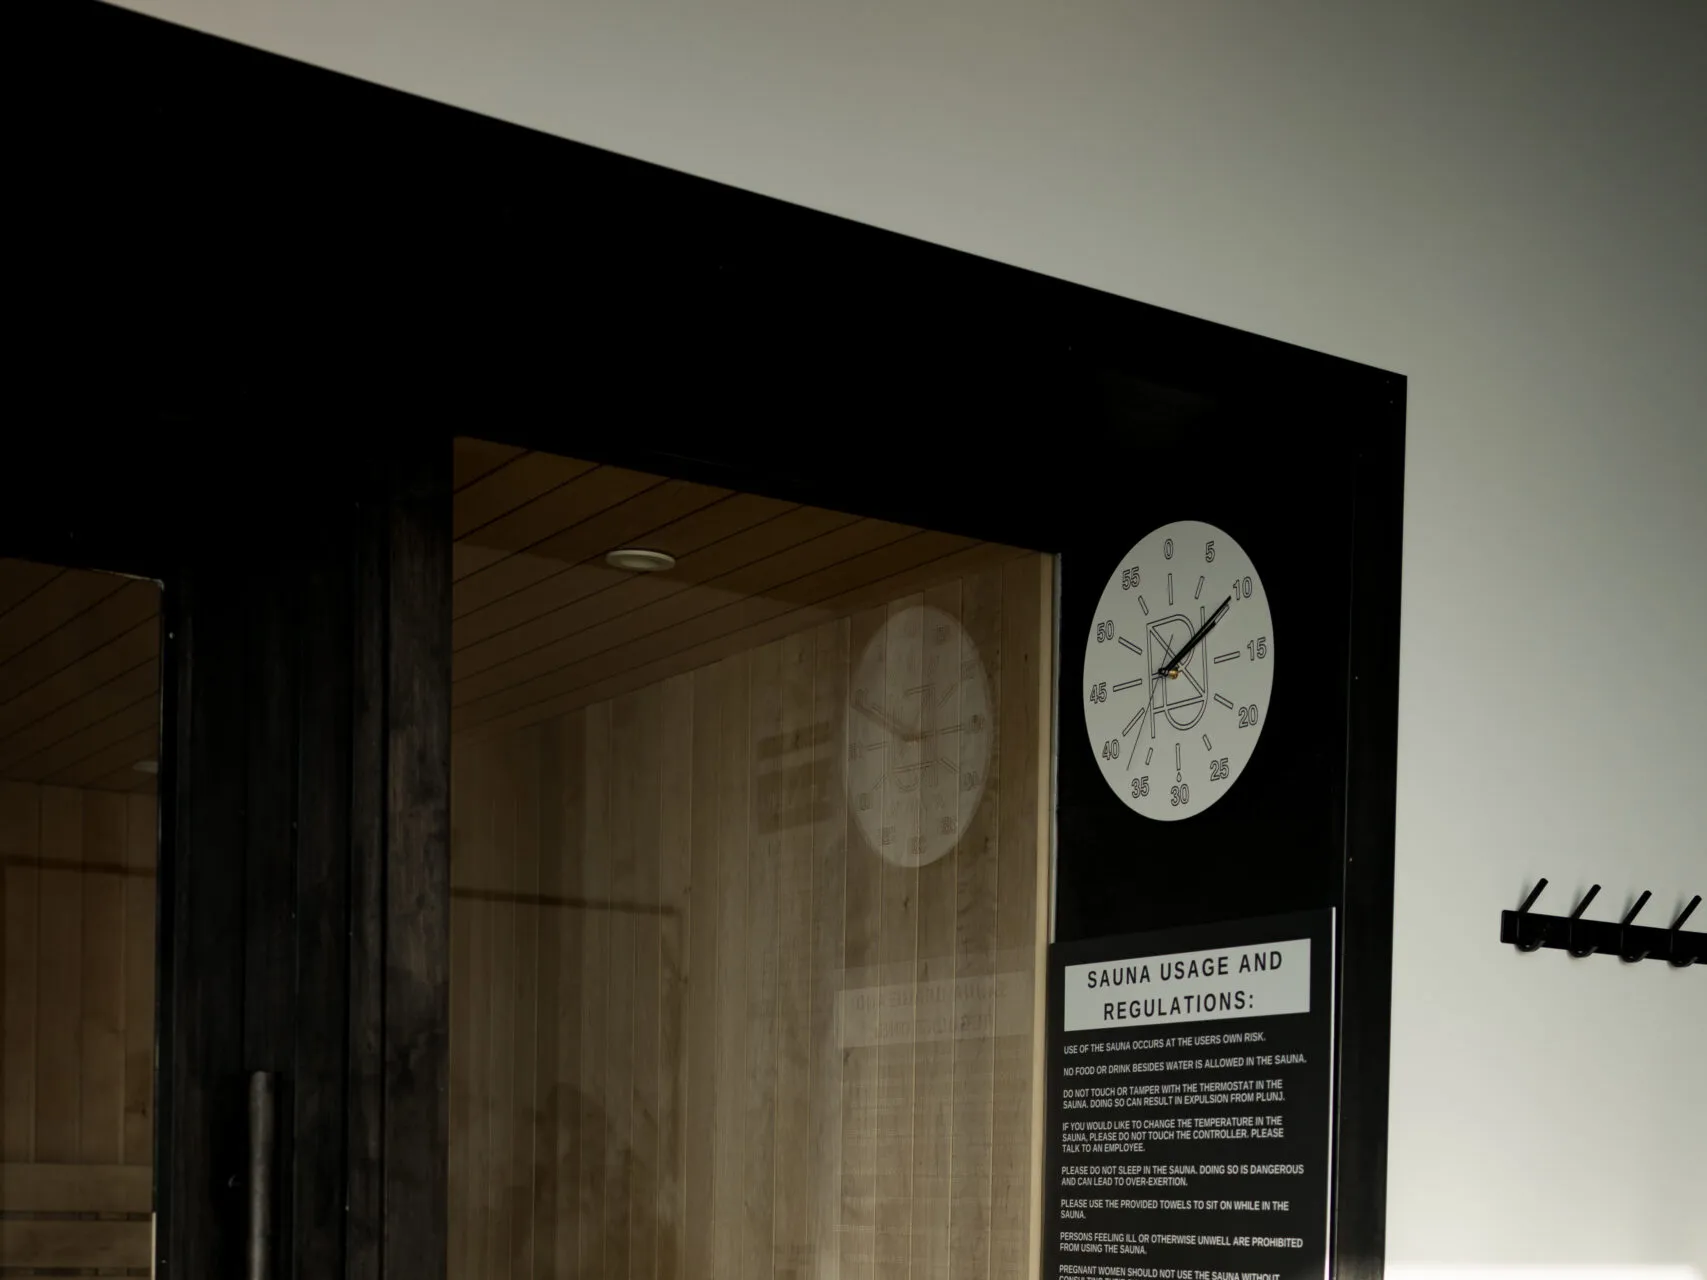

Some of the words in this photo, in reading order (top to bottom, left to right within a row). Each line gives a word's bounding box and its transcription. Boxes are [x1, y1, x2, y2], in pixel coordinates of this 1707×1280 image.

[1164, 539, 1174, 559] 0
[1205, 541, 1215, 562] 5
[1122, 567, 1140, 590] 55
[1233, 577, 1252, 600] 10
[1097, 620, 1114, 642] 50
[1247, 637, 1267, 661] 15
[1090, 682, 1107, 703] 45
[1238, 704, 1258, 728] 20
[1102, 739, 1120, 760] 40
[1210, 758, 1229, 781] 25
[1132, 776, 1149, 798] 35
[1171, 784, 1189, 806] 30
[1087, 965, 1150, 988] SAUNA
[1160, 956, 1228, 980] USAGE
[1239, 950, 1282, 973] AND
[1104, 990, 1254, 1020] REGULATIONS:
[1064, 1045, 1078, 1054] USE
[1079, 1044, 1089, 1053] OF
[1091, 1043, 1104, 1052] THE
[1106, 1042, 1131, 1051] SAUNA
[1132, 1039, 1164, 1050] OCCURS
[1166, 1038, 1176, 1047] AT
[1178, 1037, 1193, 1047] THE
[1194, 1036, 1221, 1046] USERS
[1223, 1034, 1242, 1044] OWN
[1244, 1032, 1266, 1042] RISK.
[1063, 1068, 1074, 1076] NO
[1075, 1066, 1095, 1075] FOOD
[1097, 1066, 1107, 1074] OR
[1109, 1064, 1131, 1074] DRINK
[1132, 1062, 1164, 1072] BESIDES
[1166, 1060, 1194, 1071] WATER
[1195, 1060, 1203, 1069] IS
[1205, 1058, 1244, 1069] ALLOWED
[1246, 1057, 1254, 1067] IN
[1256, 1056, 1273, 1066] THE
[1274, 1054, 1306, 1065] SAUNA.
[1063, 1089, 1073, 1098] DO
[1075, 1088, 1089, 1098] NOT
[1091, 1087, 1115, 1097] TOUCH
[1117, 1087, 1128, 1096] OR
[1130, 1085, 1160, 1095] TAMPER
[1162, 1084, 1181, 1094] WITH
[1182, 1083, 1198, 1093] THE
[1200, 1081, 1254, 1092] THERMOSTAT
[1255, 1080, 1264, 1090] IN
[1266, 1080, 1283, 1090] THE
[1063, 1099, 1088, 1109] SAUNA.
[1090, 1098, 1113, 1108] DOING
[1114, 1098, 1125, 1107] SO
[1126, 1097, 1142, 1107] CAN
[1144, 1096, 1173, 1106] RESULT
[1175, 1096, 1182, 1105] IN
[1184, 1094, 1228, 1105] EXPULSION
[1230, 1093, 1254, 1103] FROM
[1256, 1092, 1285, 1102] PLUNJ.
[1062, 1122, 1069, 1131] IF
[1070, 1122, 1085, 1130] YOU
[1087, 1121, 1112, 1130] WOULD
[1114, 1120, 1130, 1129] LIKE
[1132, 1120, 1142, 1129] TO
[1144, 1119, 1176, 1129] CHANGE
[1177, 1119, 1193, 1128] THE
[1194, 1117, 1253, 1127] TEMPERATURE
[1255, 1117, 1264, 1126] IN
[1266, 1116, 1283, 1126] THE
[1089, 1132, 1117, 1141] PLEASE
[1119, 1132, 1129, 1141] DO
[1131, 1131, 1147, 1140] NOT
[1148, 1131, 1174, 1140] TOUCH
[1176, 1130, 1191, 1140] THE
[1193, 1129, 1248, 1139] CONTROLLER.
[1250, 1128, 1284, 1138] PLEASE
[1062, 1144, 1080, 1152] TALK
[1082, 1144, 1091, 1152] TO
[1093, 1144, 1103, 1152] AN
[1104, 1143, 1145, 1152] EMPLOYEE.
[1062, 1166, 1088, 1174] PLEASE
[1090, 1166, 1100, 1174] DO
[1102, 1166, 1117, 1174] NOT
[1118, 1165, 1142, 1174] SLEEP
[1144, 1165, 1151, 1174] IN
[1153, 1165, 1167, 1174] THE
[1169, 1165, 1198, 1174] SAUNA.
[1199, 1165, 1225, 1174] DOING
[1227, 1165, 1239, 1174] SO
[1240, 1165, 1248, 1174] IS
[1250, 1164, 1304, 1174] DANGEROUS
[1061, 1177, 1076, 1185] AND
[1078, 1177, 1092, 1185] CAN
[1094, 1177, 1113, 1185] LEAD
[1114, 1177, 1124, 1186] TO
[1126, 1177, 1188, 1186] OVER-EXERTION.
[1060, 1210, 1086, 1219] SAUNA.
[1061, 1200, 1087, 1208] PLEASE
[1089, 1200, 1103, 1208] USE
[1105, 1200, 1119, 1208] THE
[1121, 1200, 1158, 1209] PROVIDED
[1160, 1200, 1192, 1209] TOWELS
[1194, 1200, 1204, 1209] TO
[1206, 1201, 1218, 1210] SIT
[1220, 1201, 1232, 1210] ON
[1234, 1201, 1260, 1210] WHILE
[1262, 1201, 1270, 1210] IN
[1272, 1201, 1289, 1210] THE
[1059, 1243, 1079, 1252] FROM
[1081, 1244, 1102, 1253] USING
[1104, 1244, 1118, 1253] THE
[1120, 1245, 1147, 1254] SAUNA.
[1060, 1232, 1092, 1241] PERSONS
[1094, 1233, 1124, 1242] FEELING
[1126, 1234, 1136, 1243] ILL
[1138, 1234, 1149, 1243] OR
[1151, 1234, 1196, 1244] OTHERWISE
[1198, 1236, 1231, 1246] UNWELL
[1233, 1236, 1250, 1246] ARE
[1252, 1237, 1303, 1248] PROHIBITED
[1059, 1265, 1096, 1275] PREGNANT
[1098, 1266, 1126, 1276] WOMEN
[1128, 1268, 1158, 1278] SHOULD
[1160, 1269, 1175, 1278] NOT
[1177, 1270, 1193, 1279] USE
[1194, 1270, 1210, 1280] THE
[1212, 1271, 1239, 1280] SAUNA
